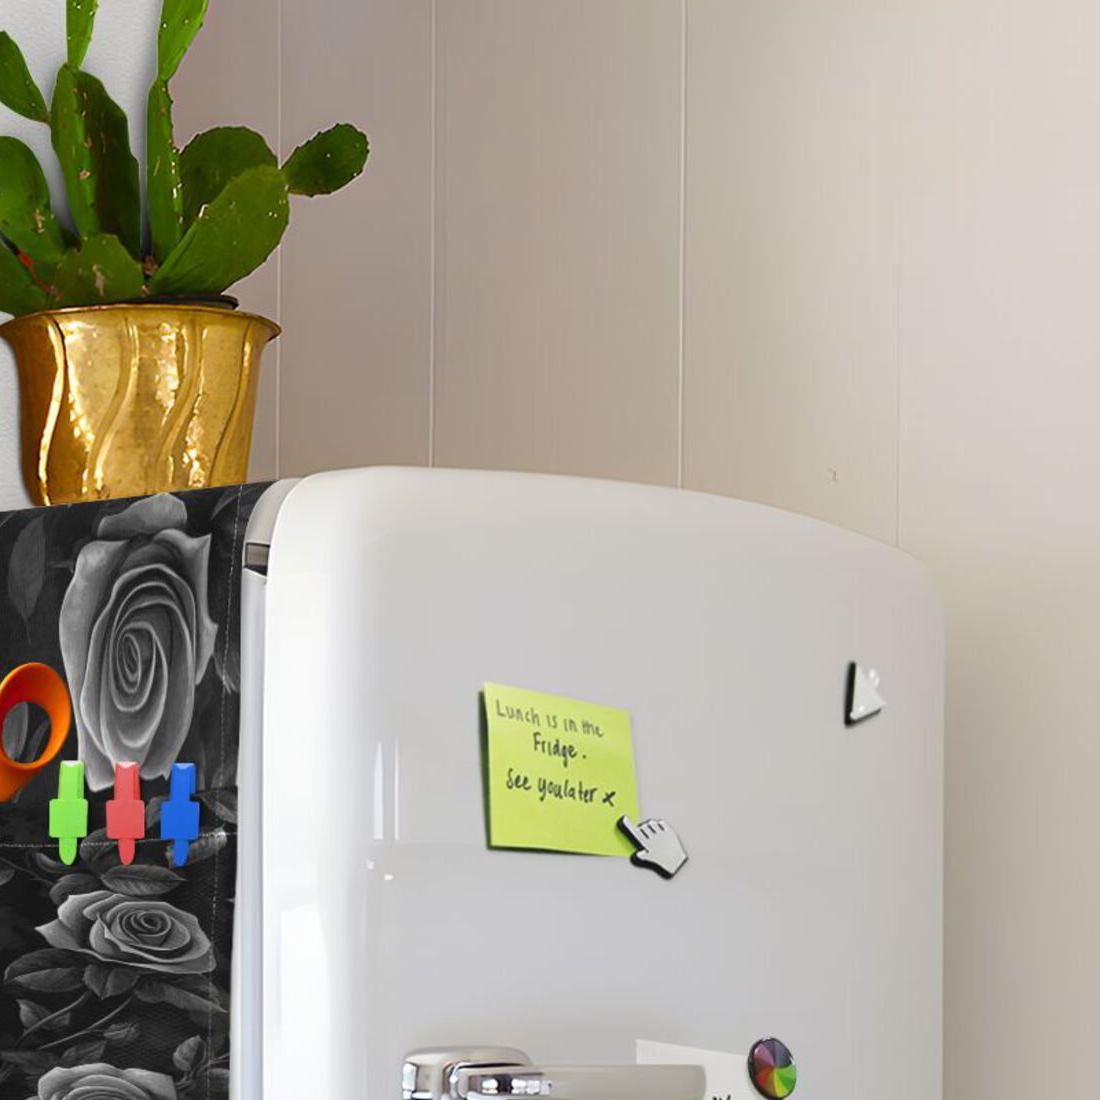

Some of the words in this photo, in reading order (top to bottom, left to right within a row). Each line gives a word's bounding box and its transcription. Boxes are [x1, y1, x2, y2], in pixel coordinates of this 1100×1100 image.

[495, 699, 540, 727] Lunch
[581, 720, 604, 738] the
[506, 768, 532, 790] See
